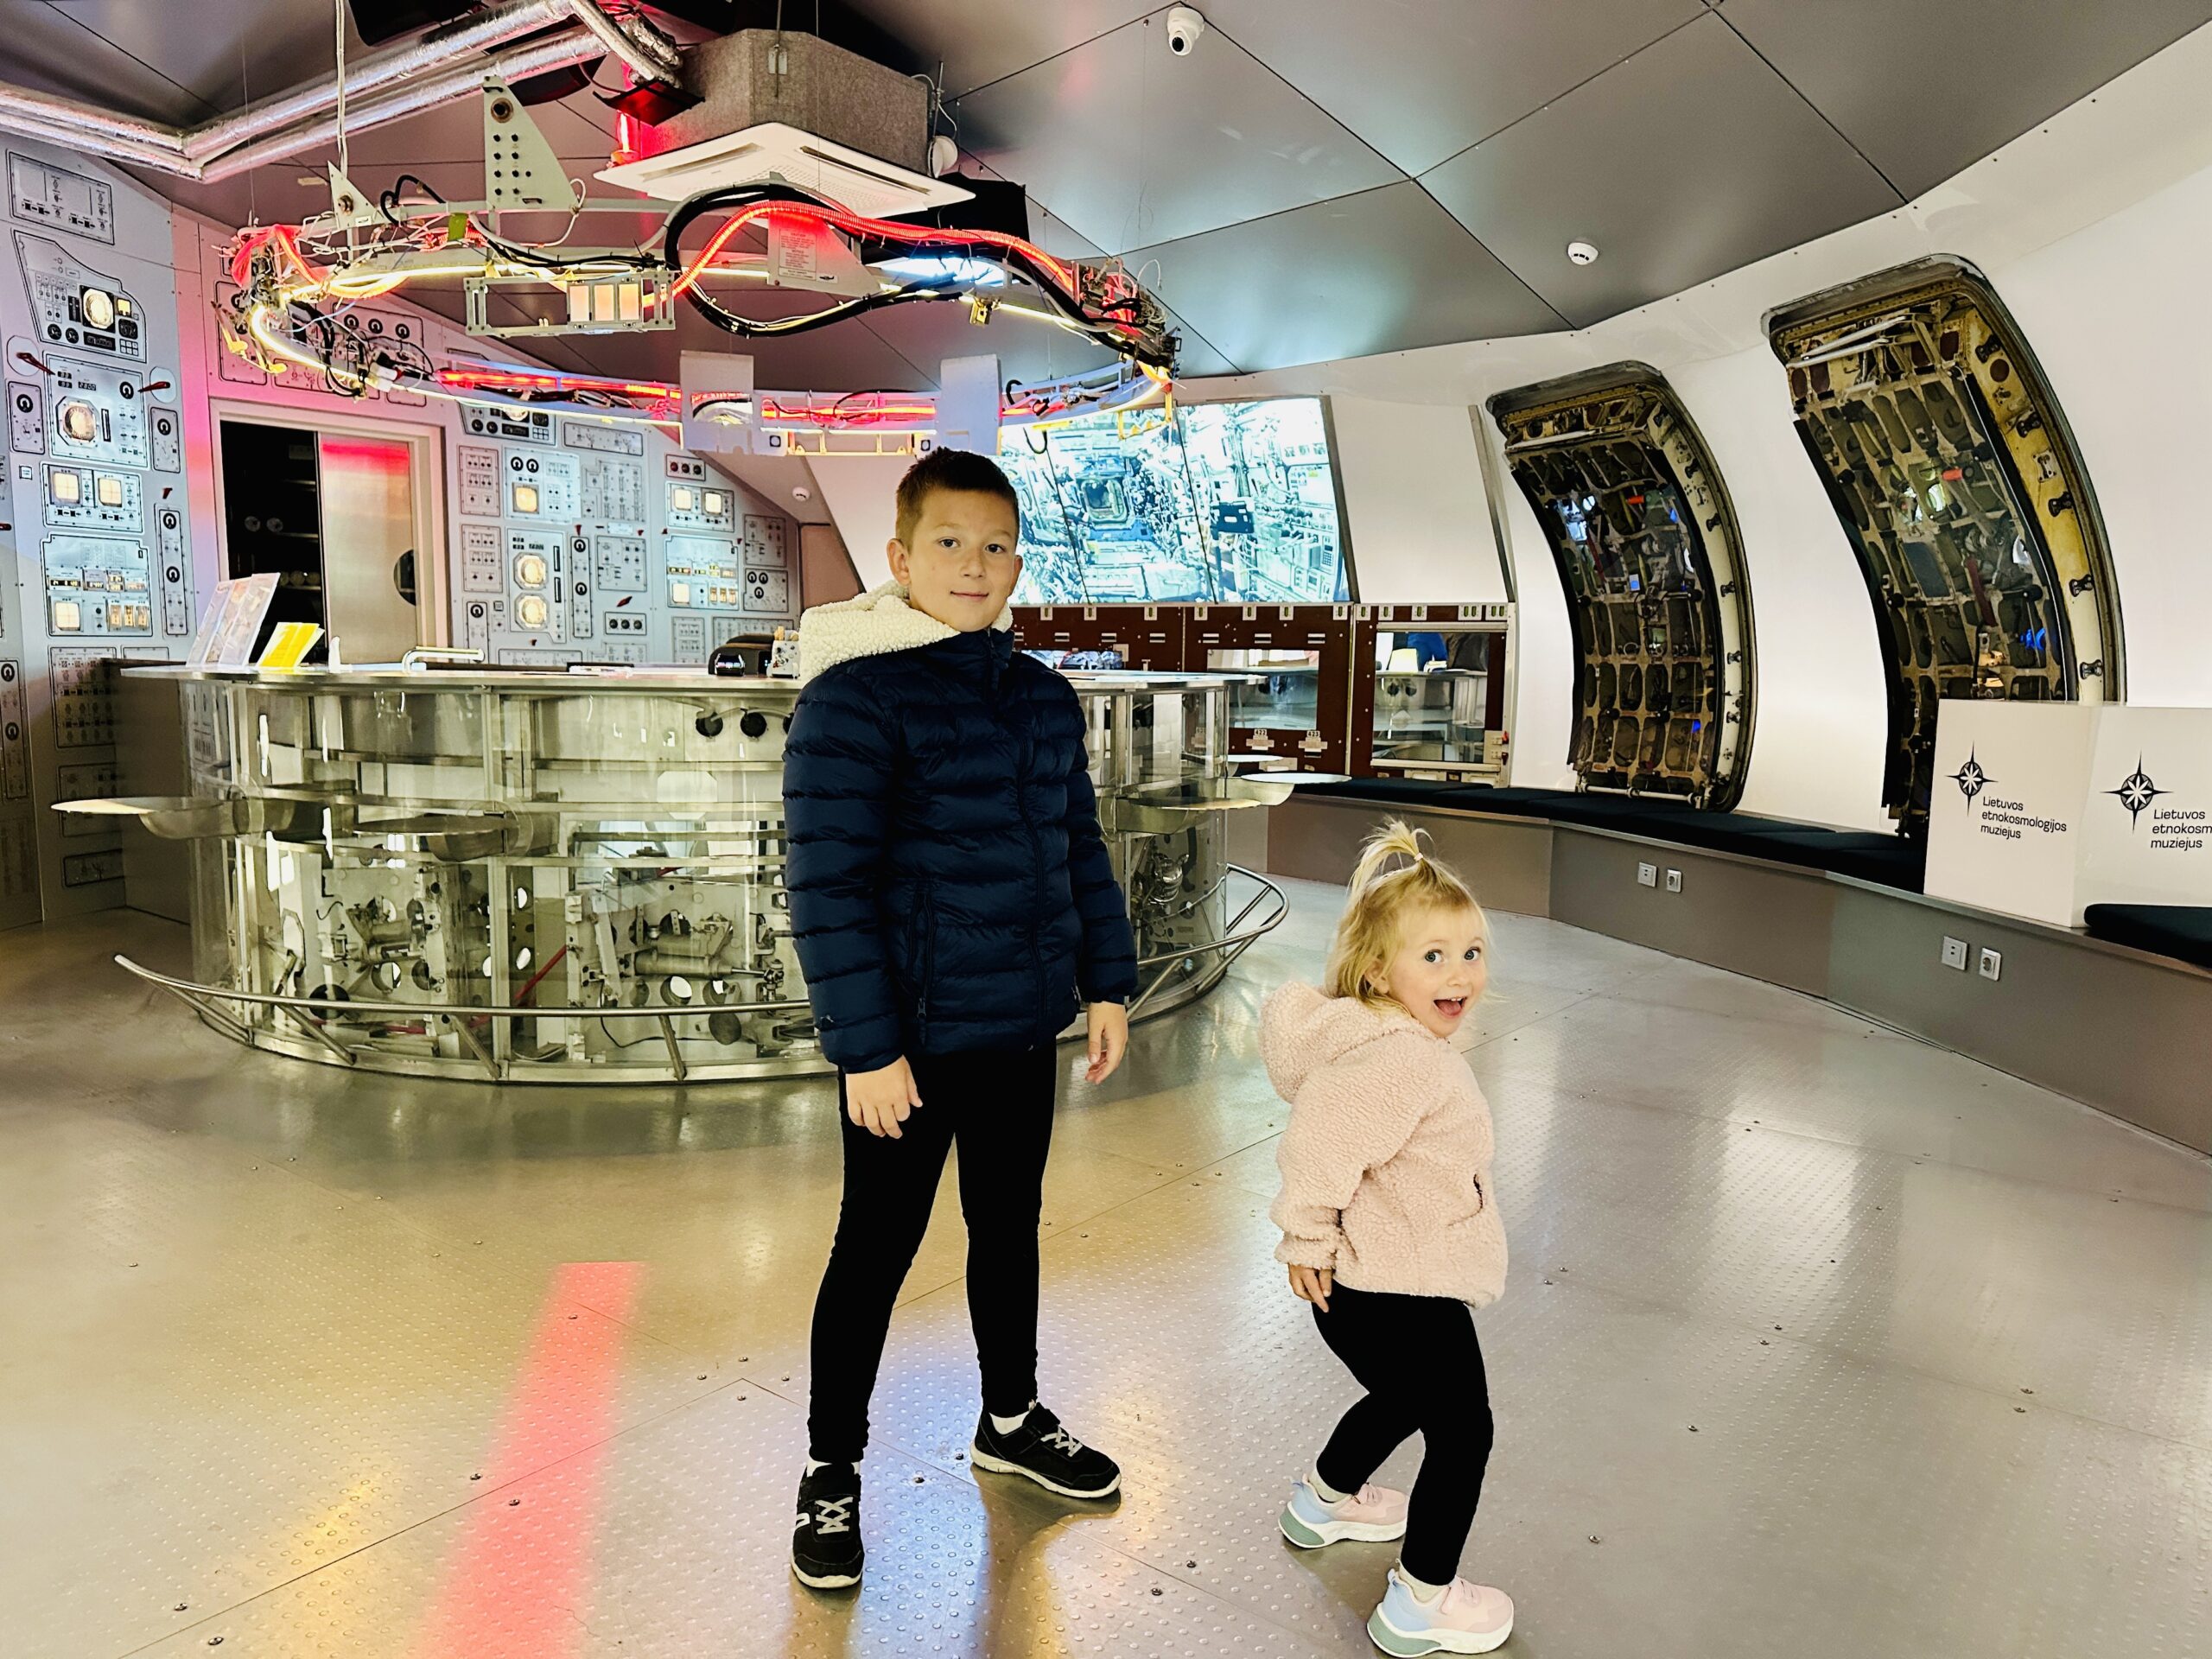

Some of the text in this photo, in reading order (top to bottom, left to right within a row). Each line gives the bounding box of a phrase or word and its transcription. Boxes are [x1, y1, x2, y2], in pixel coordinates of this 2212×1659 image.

[1983, 796, 2024, 810] Lietuvos
[1981, 810, 2067, 833] etnokosmologijos
[2153, 809, 2206, 820] Lietuvos
[1980, 824, 2021, 840] muziejus
[2151, 837, 2203, 851] muziejus
